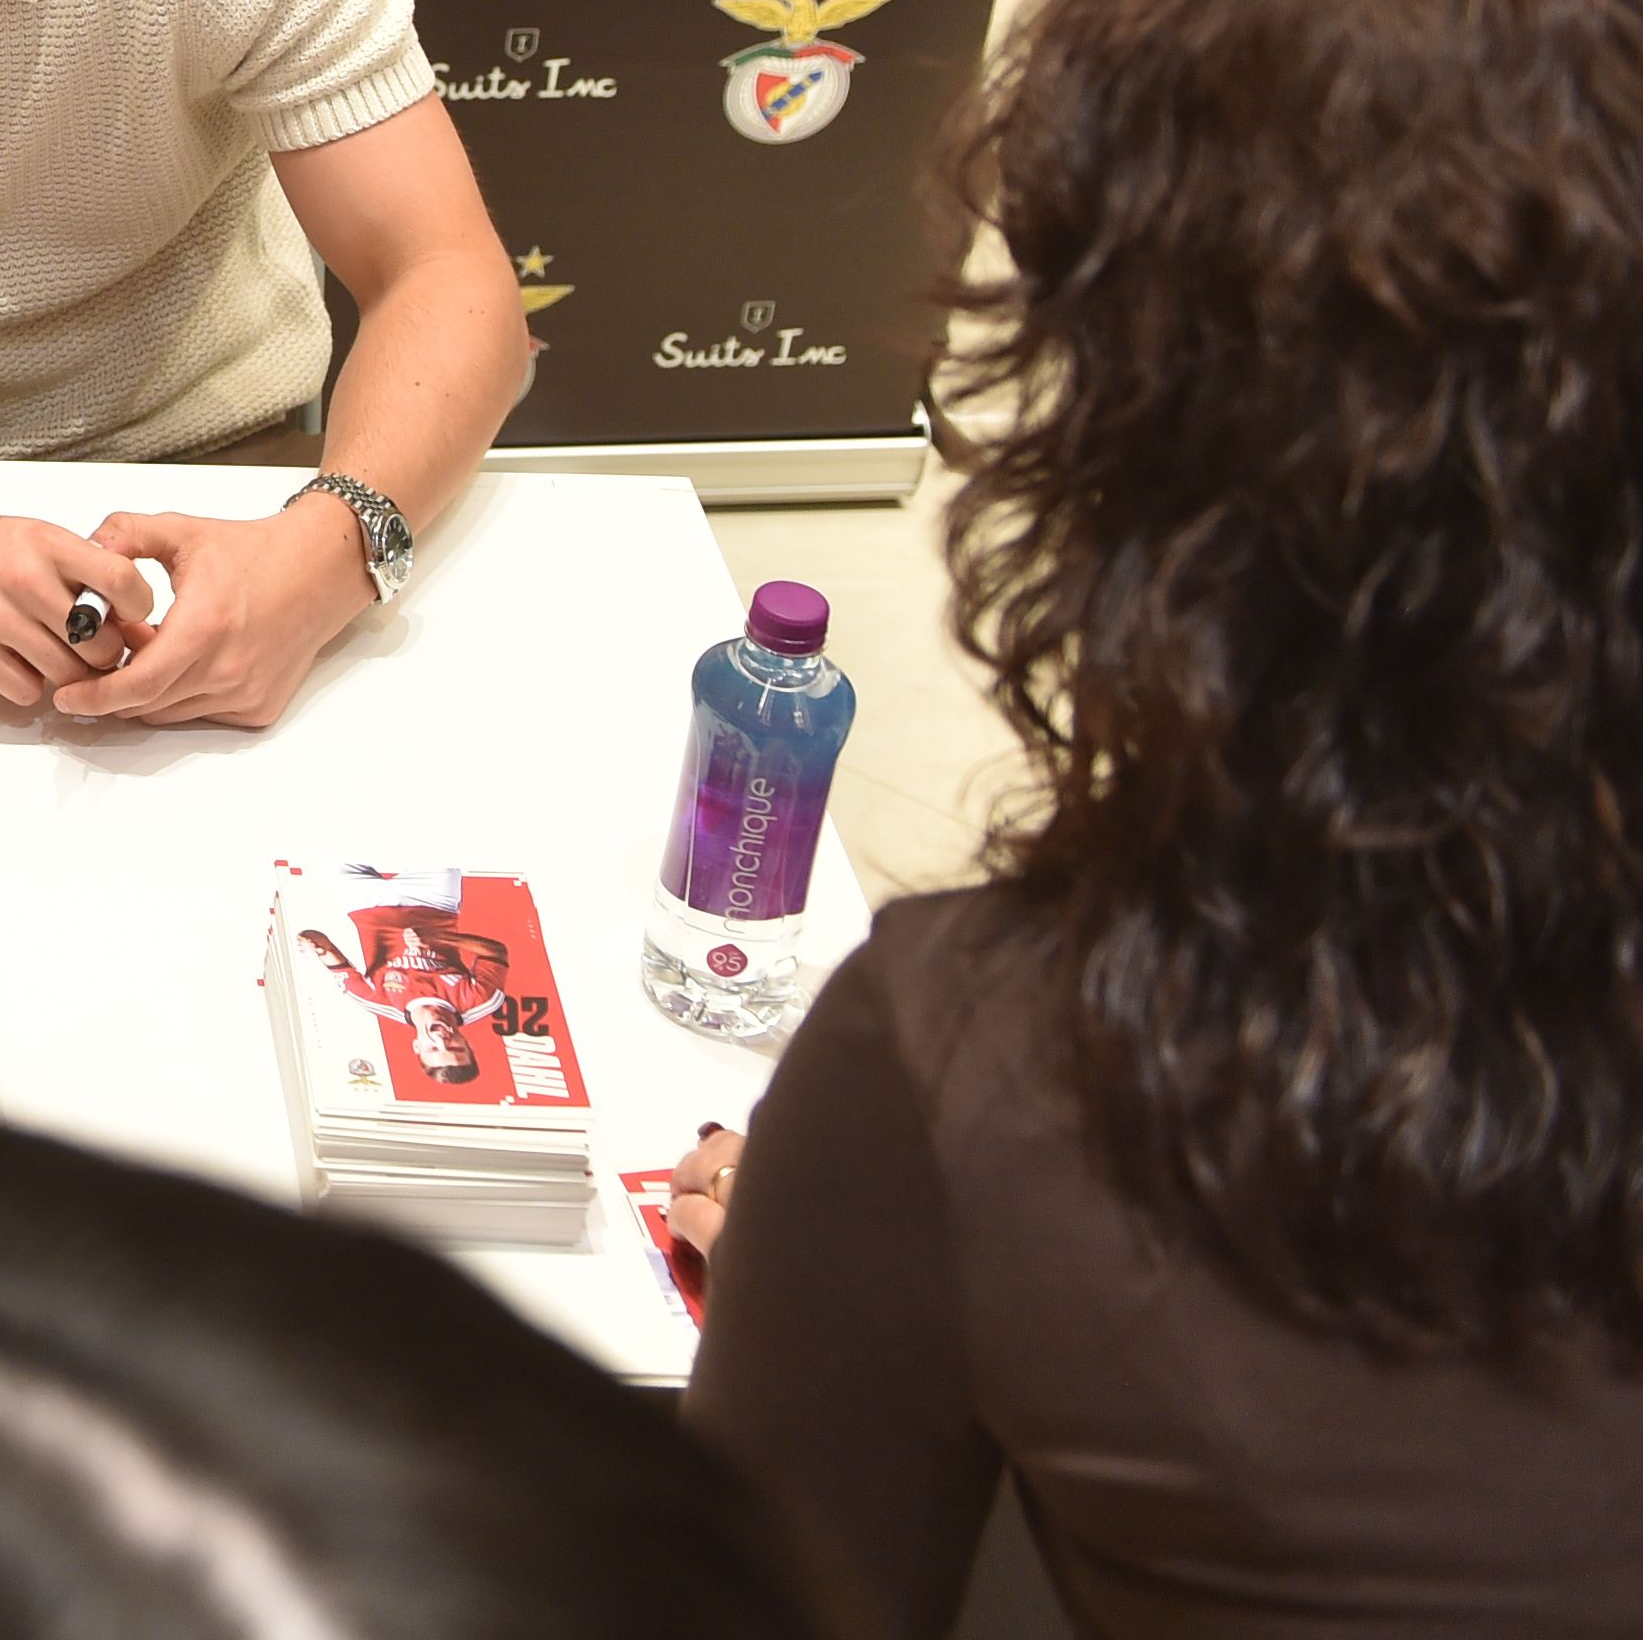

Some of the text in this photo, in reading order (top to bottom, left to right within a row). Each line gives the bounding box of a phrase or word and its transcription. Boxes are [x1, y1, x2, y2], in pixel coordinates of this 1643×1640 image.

[537, 57, 617, 99] Inc
[654, 328, 846, 368] Suits Inc
[722, 776, 779, 935] monchique
[501, 1032, 572, 1100] DAHL
